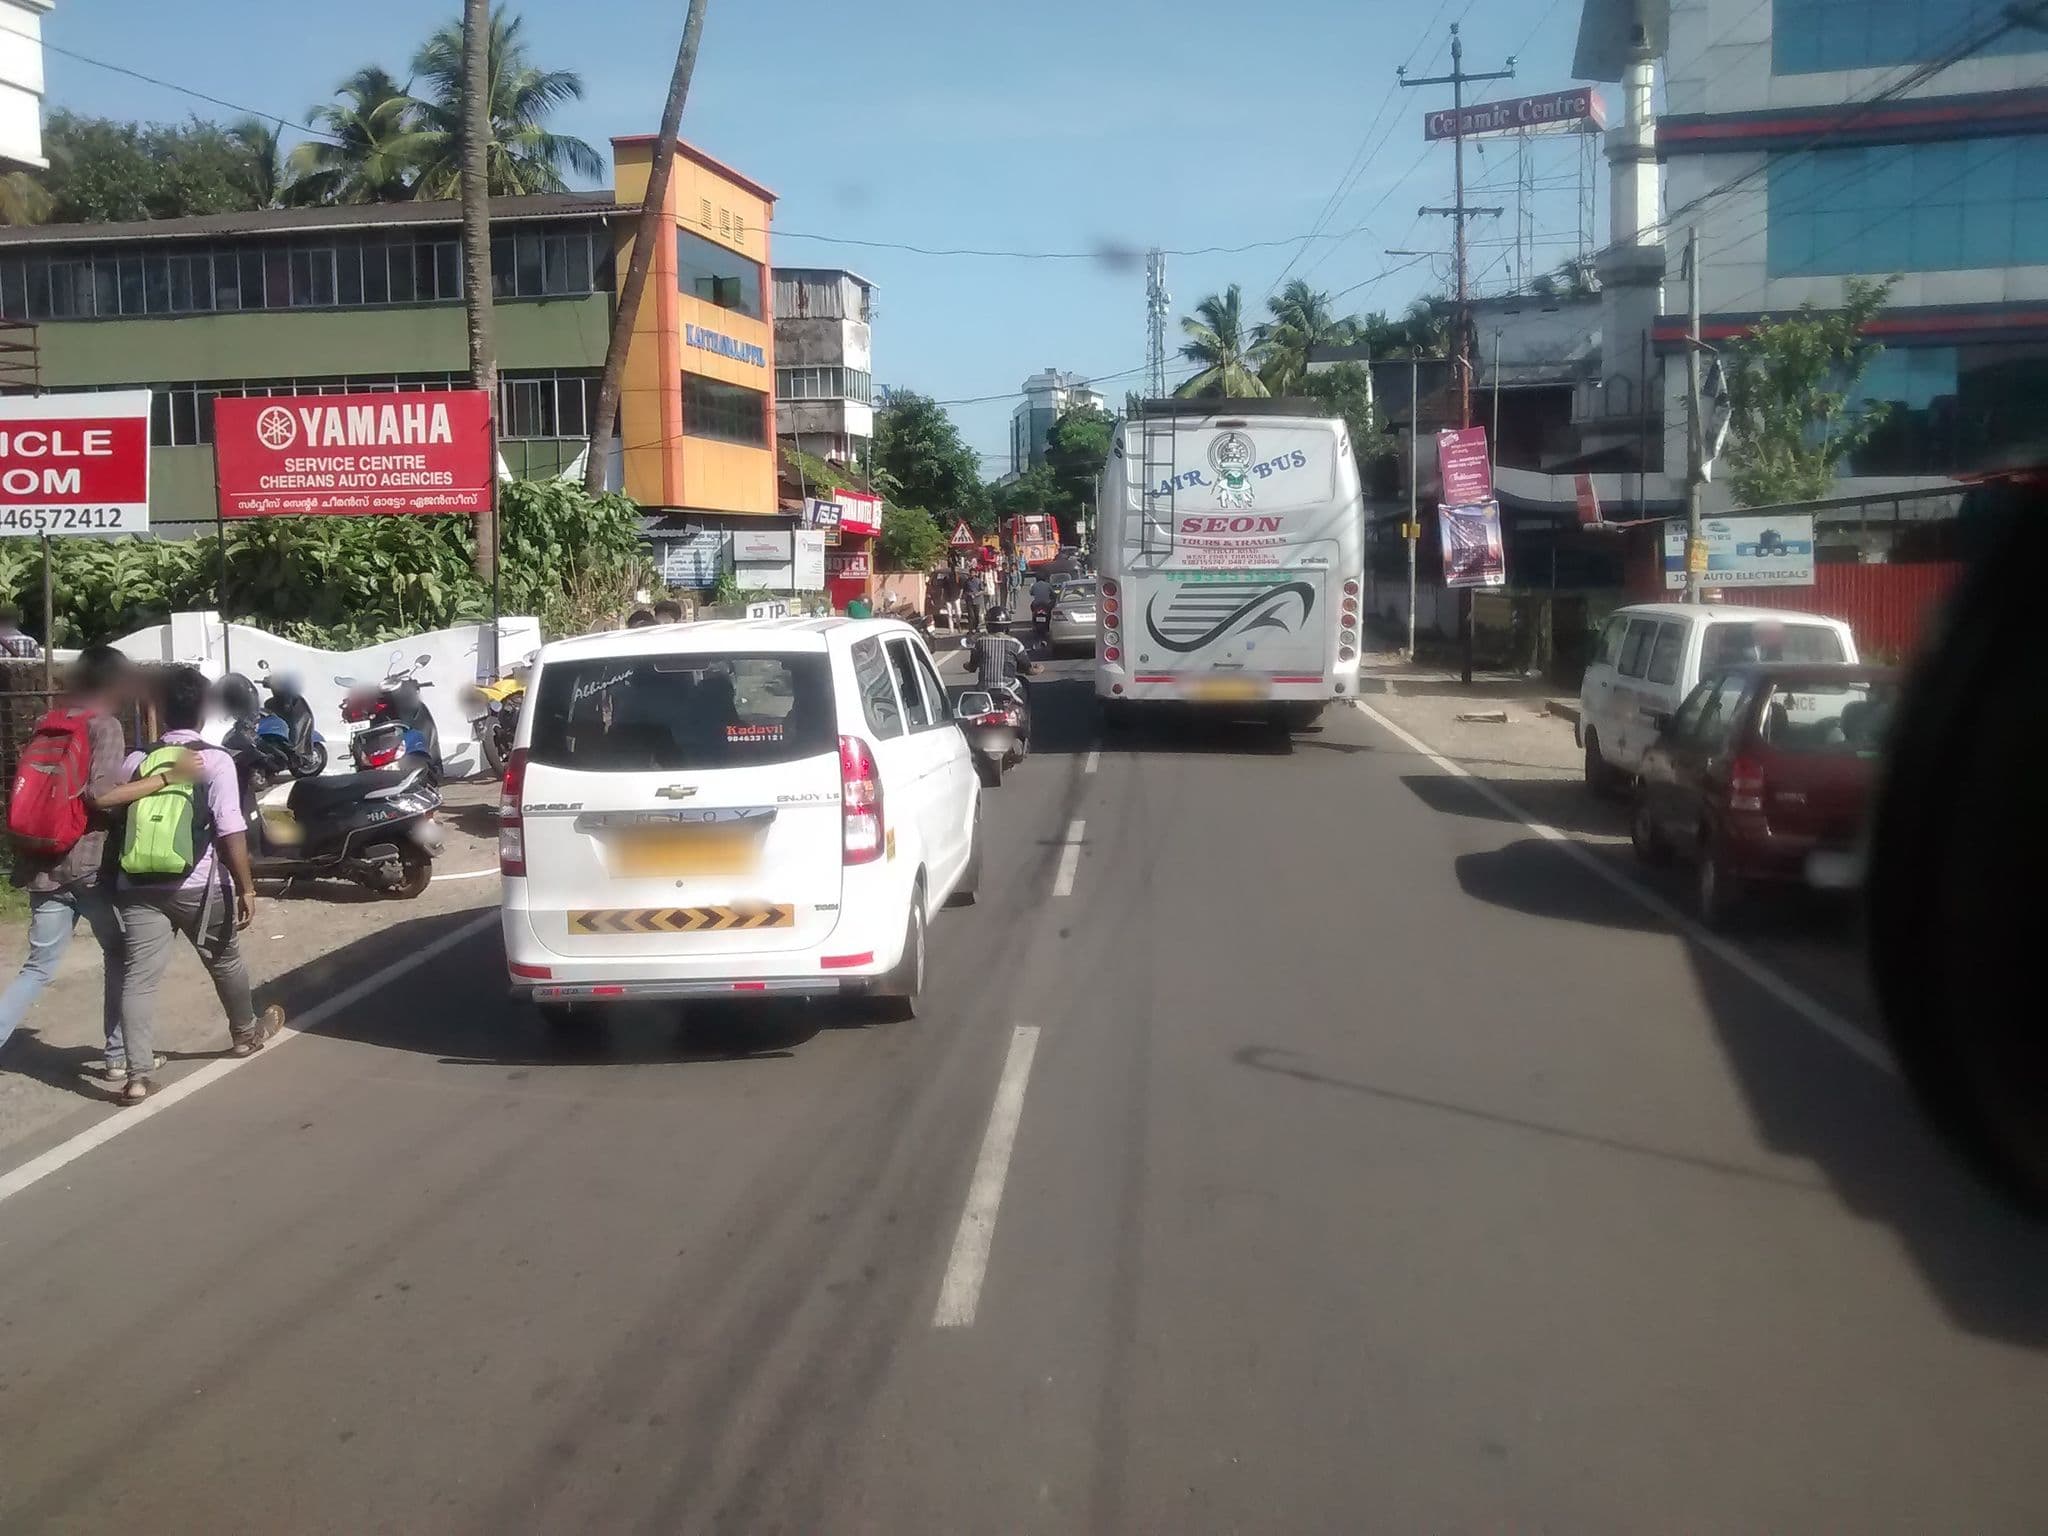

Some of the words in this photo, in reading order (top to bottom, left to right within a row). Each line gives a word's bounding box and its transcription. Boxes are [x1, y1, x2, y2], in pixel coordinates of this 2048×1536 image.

[1430, 105, 1509, 137] Ceamic
[1518, 96, 1585, 122] Centre
[299, 403, 453, 447] YAMAHA
[284, 457, 355, 473] SERVICE
[359, 455, 426, 472] CENTRE
[2, 468, 81, 494] OM
[259, 474, 335, 489] CHEERANS
[338, 473, 377, 487] AUTO
[380, 472, 453, 486] AGENCIES
[1151, 470, 1212, 499] AIR
[1253, 450, 1307, 479] BUS
[0, 508, 122, 529] 46572412
[1180, 516, 1283, 533] SEON
[1182, 538, 1220, 546] TOURS
[1223, 538, 1232, 546] &
[1236, 537, 1287, 546] TRAVELS
[1704, 572, 1733, 581] AUTO
[1737, 571, 1808, 580] ELECTRICALS
